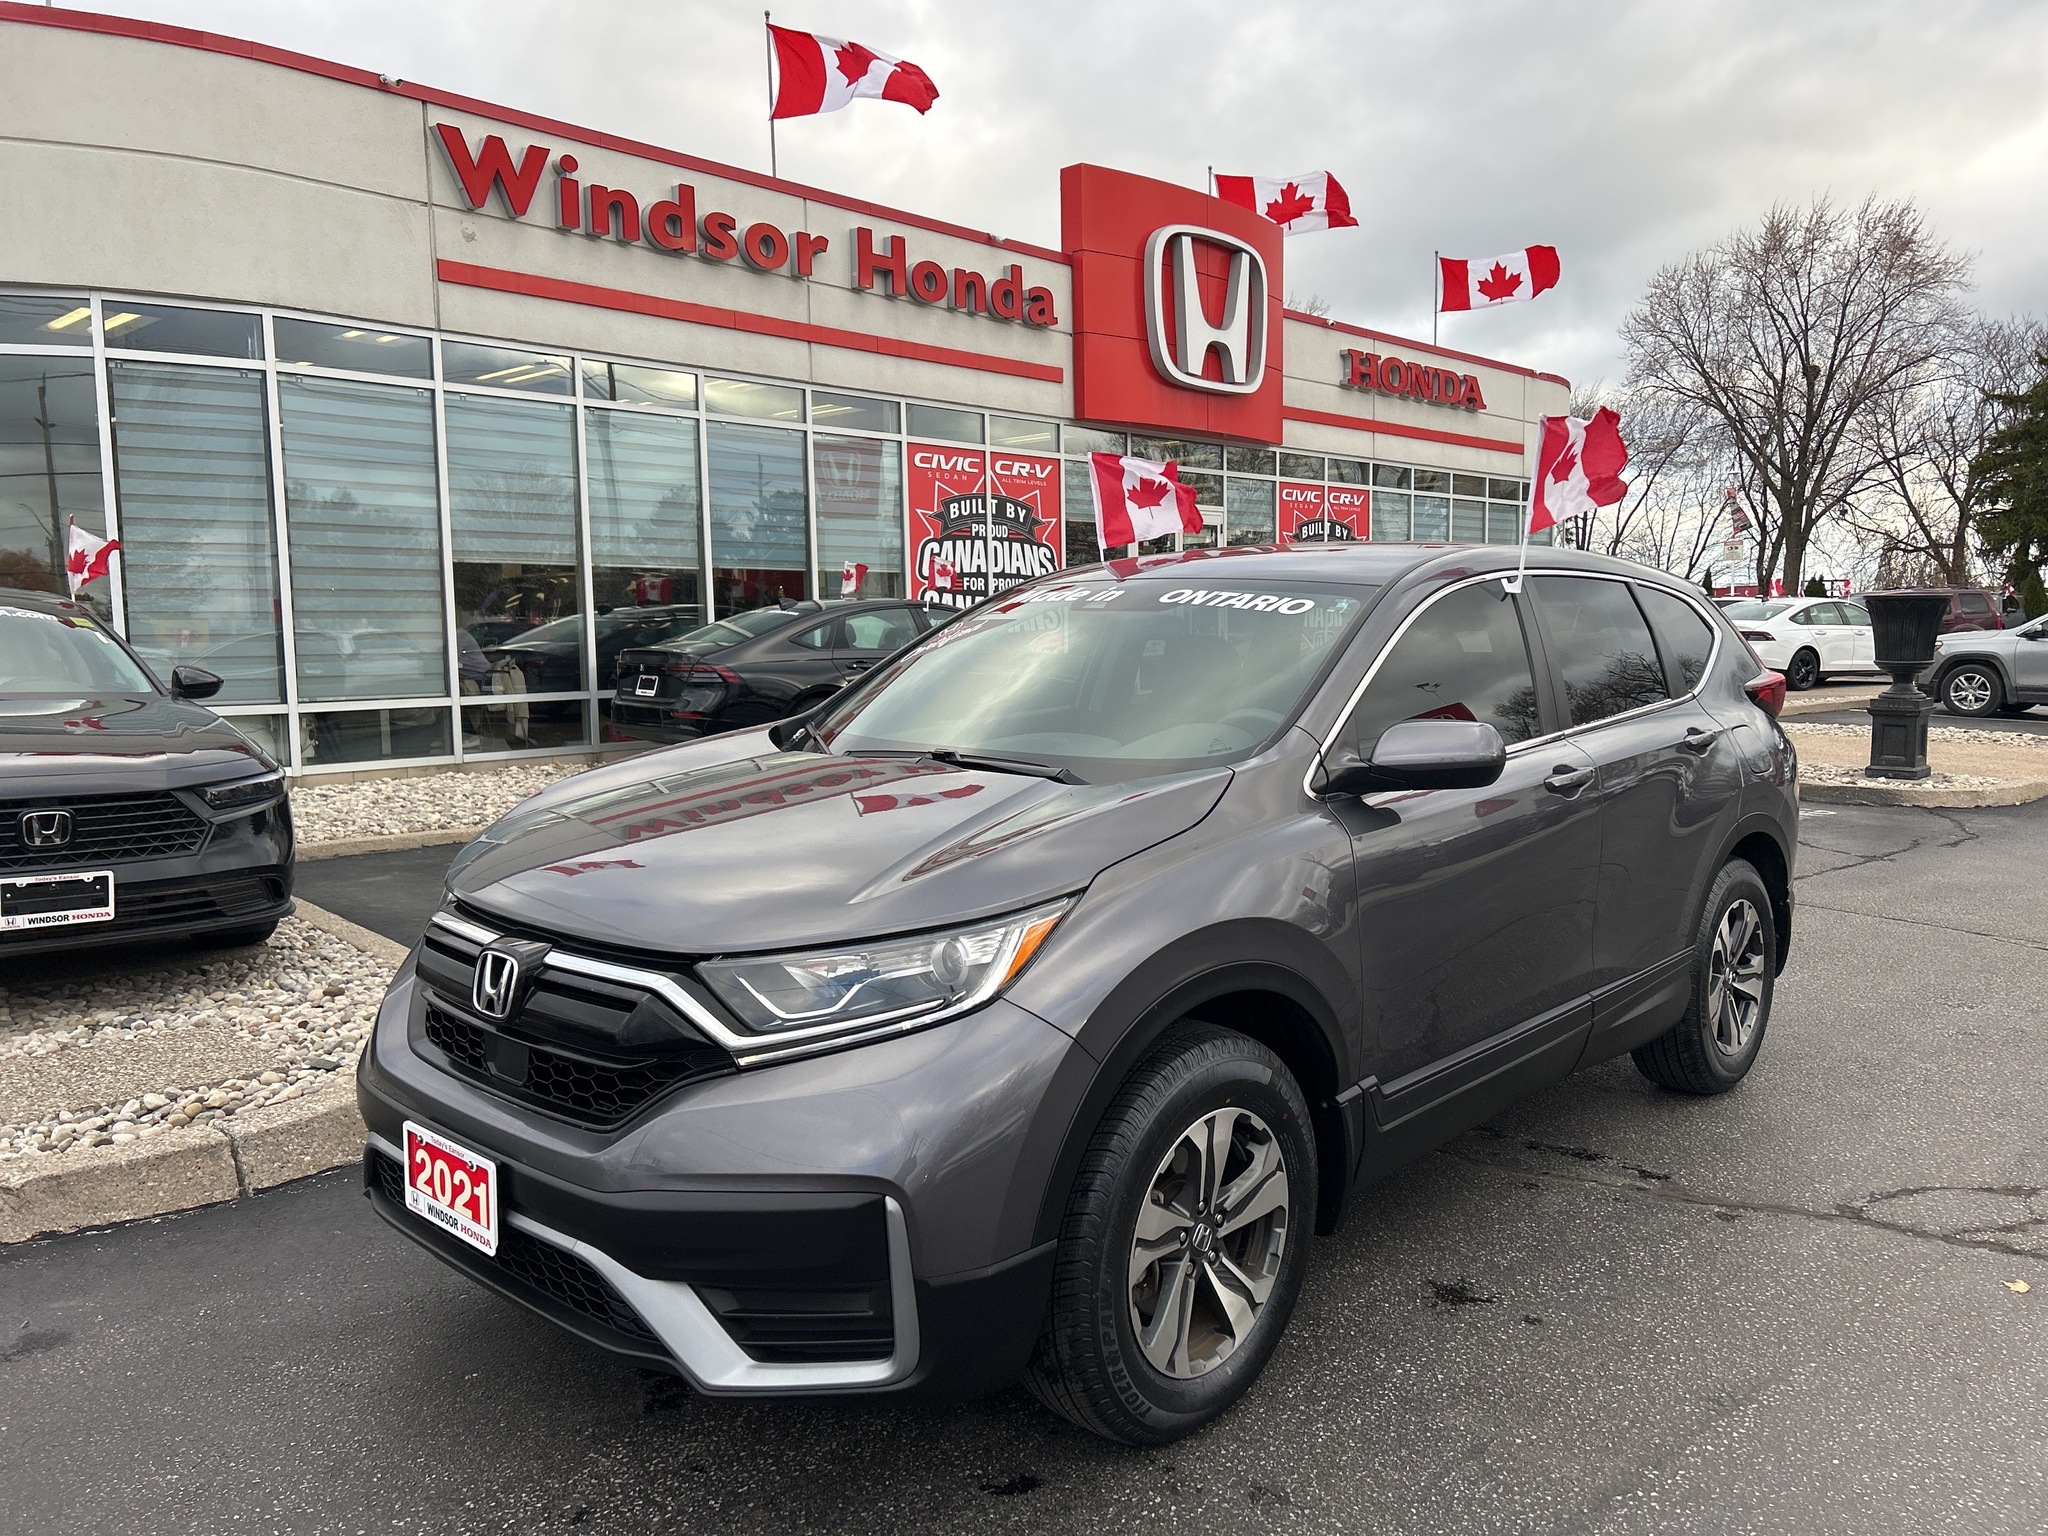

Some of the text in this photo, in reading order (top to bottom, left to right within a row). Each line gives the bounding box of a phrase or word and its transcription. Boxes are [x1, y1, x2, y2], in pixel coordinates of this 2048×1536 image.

[434, 122, 1058, 327] Windsor Honda
[1344, 348, 1487, 410] HONDA
[914, 452, 1053, 479] CIVIC CR-V
[927, 471, 968, 481] SEDAN
[949, 499, 1026, 522] BUILT BY
[1282, 488, 1365, 506] CIVIC CR-V
[1335, 524, 1349, 540] BY
[963, 577, 985, 591] FOR
[1158, 588, 1296, 615] ONTARIO
[27, 911, 112, 925] WINDSOR HONDA
[415, 1148, 488, 1230] 2021
[426, 1201, 493, 1249] WINDSOR HONDA
[1110, 1365, 1153, 1419] TIGER
